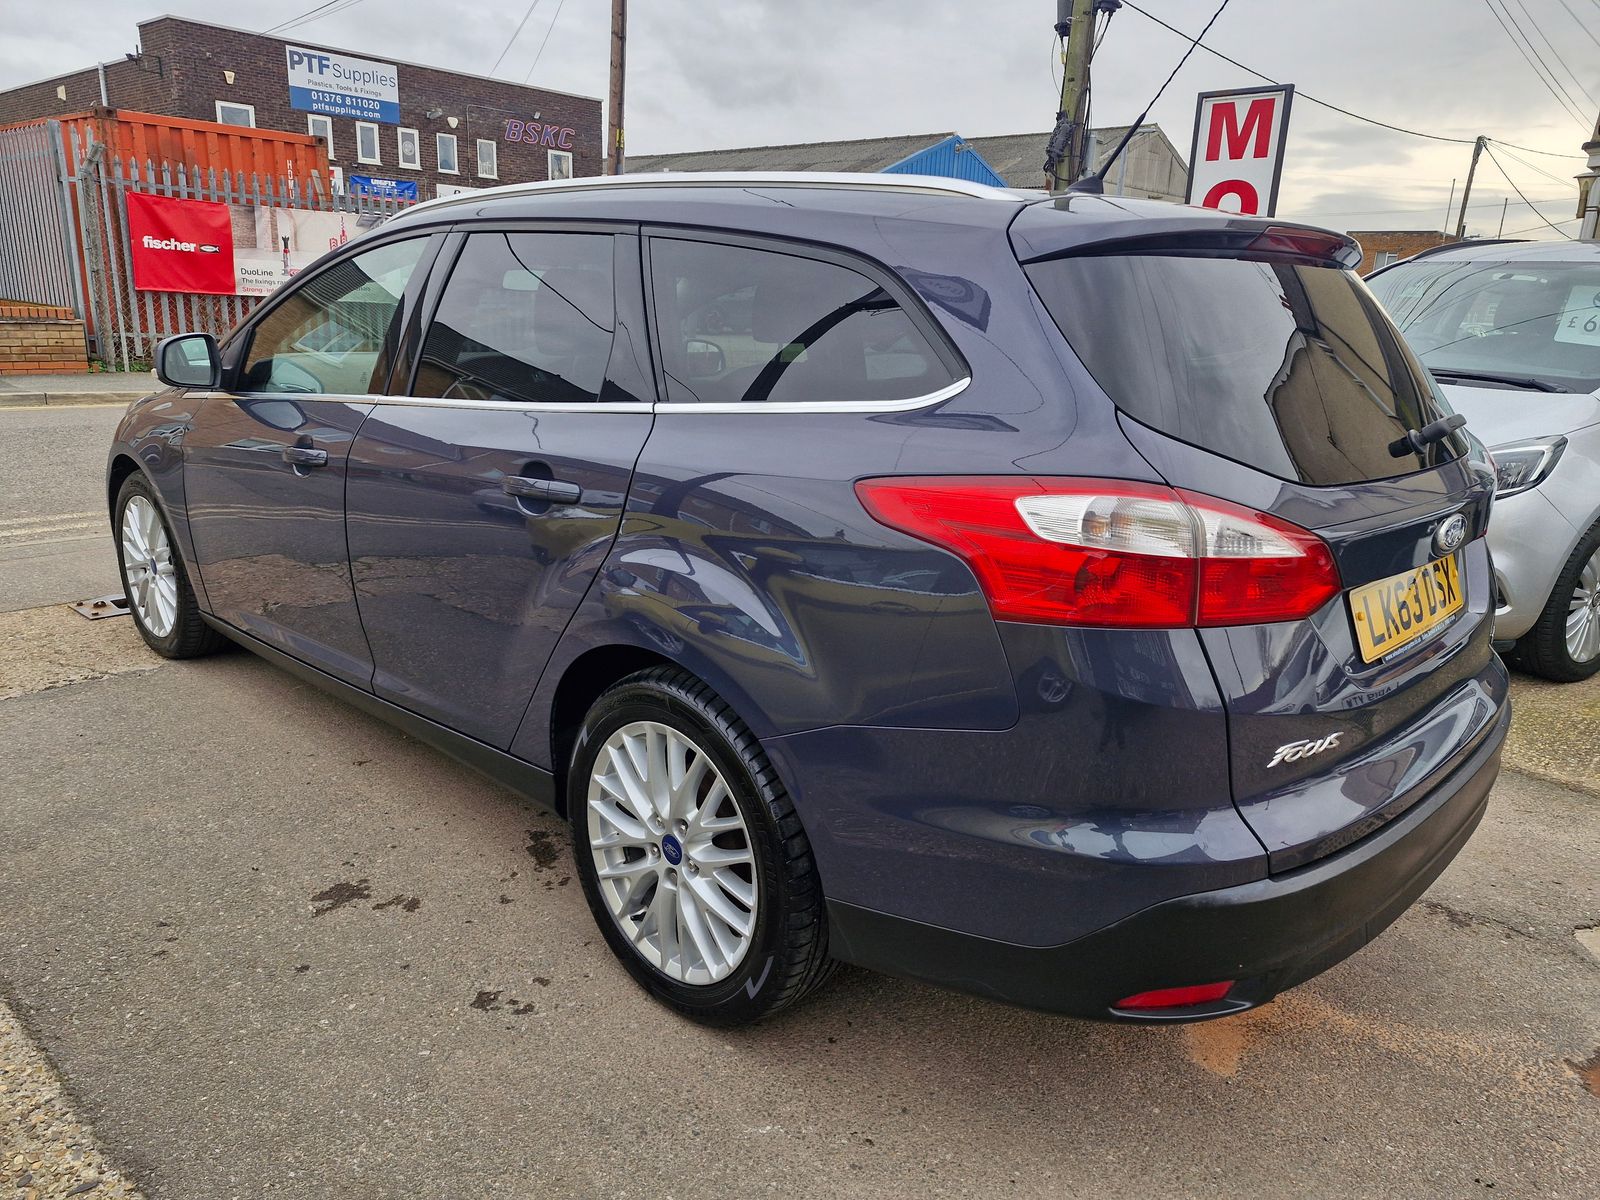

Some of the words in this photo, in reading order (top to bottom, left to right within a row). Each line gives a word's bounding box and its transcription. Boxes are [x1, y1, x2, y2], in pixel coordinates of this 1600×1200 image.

[288, 50, 330, 75] PTF
[332, 63, 396, 88] Supplies
[336, 83, 352, 92] Tools
[360, 88, 382, 98] Fixings
[311, 91, 342, 104] 01376
[345, 96, 380, 110] 811020
[312, 102, 381, 119] ptfsupplies.com
[504, 119, 575, 149] BSKC
[142, 235, 196, 252] fischer
[240, 267, 273, 276] DuoLine
[242, 286, 263, 294] Strong
[1362, 575, 1424, 647] LK63
[1422, 558, 1456, 616] DSX
[1266, 732, 1344, 768] Focus
